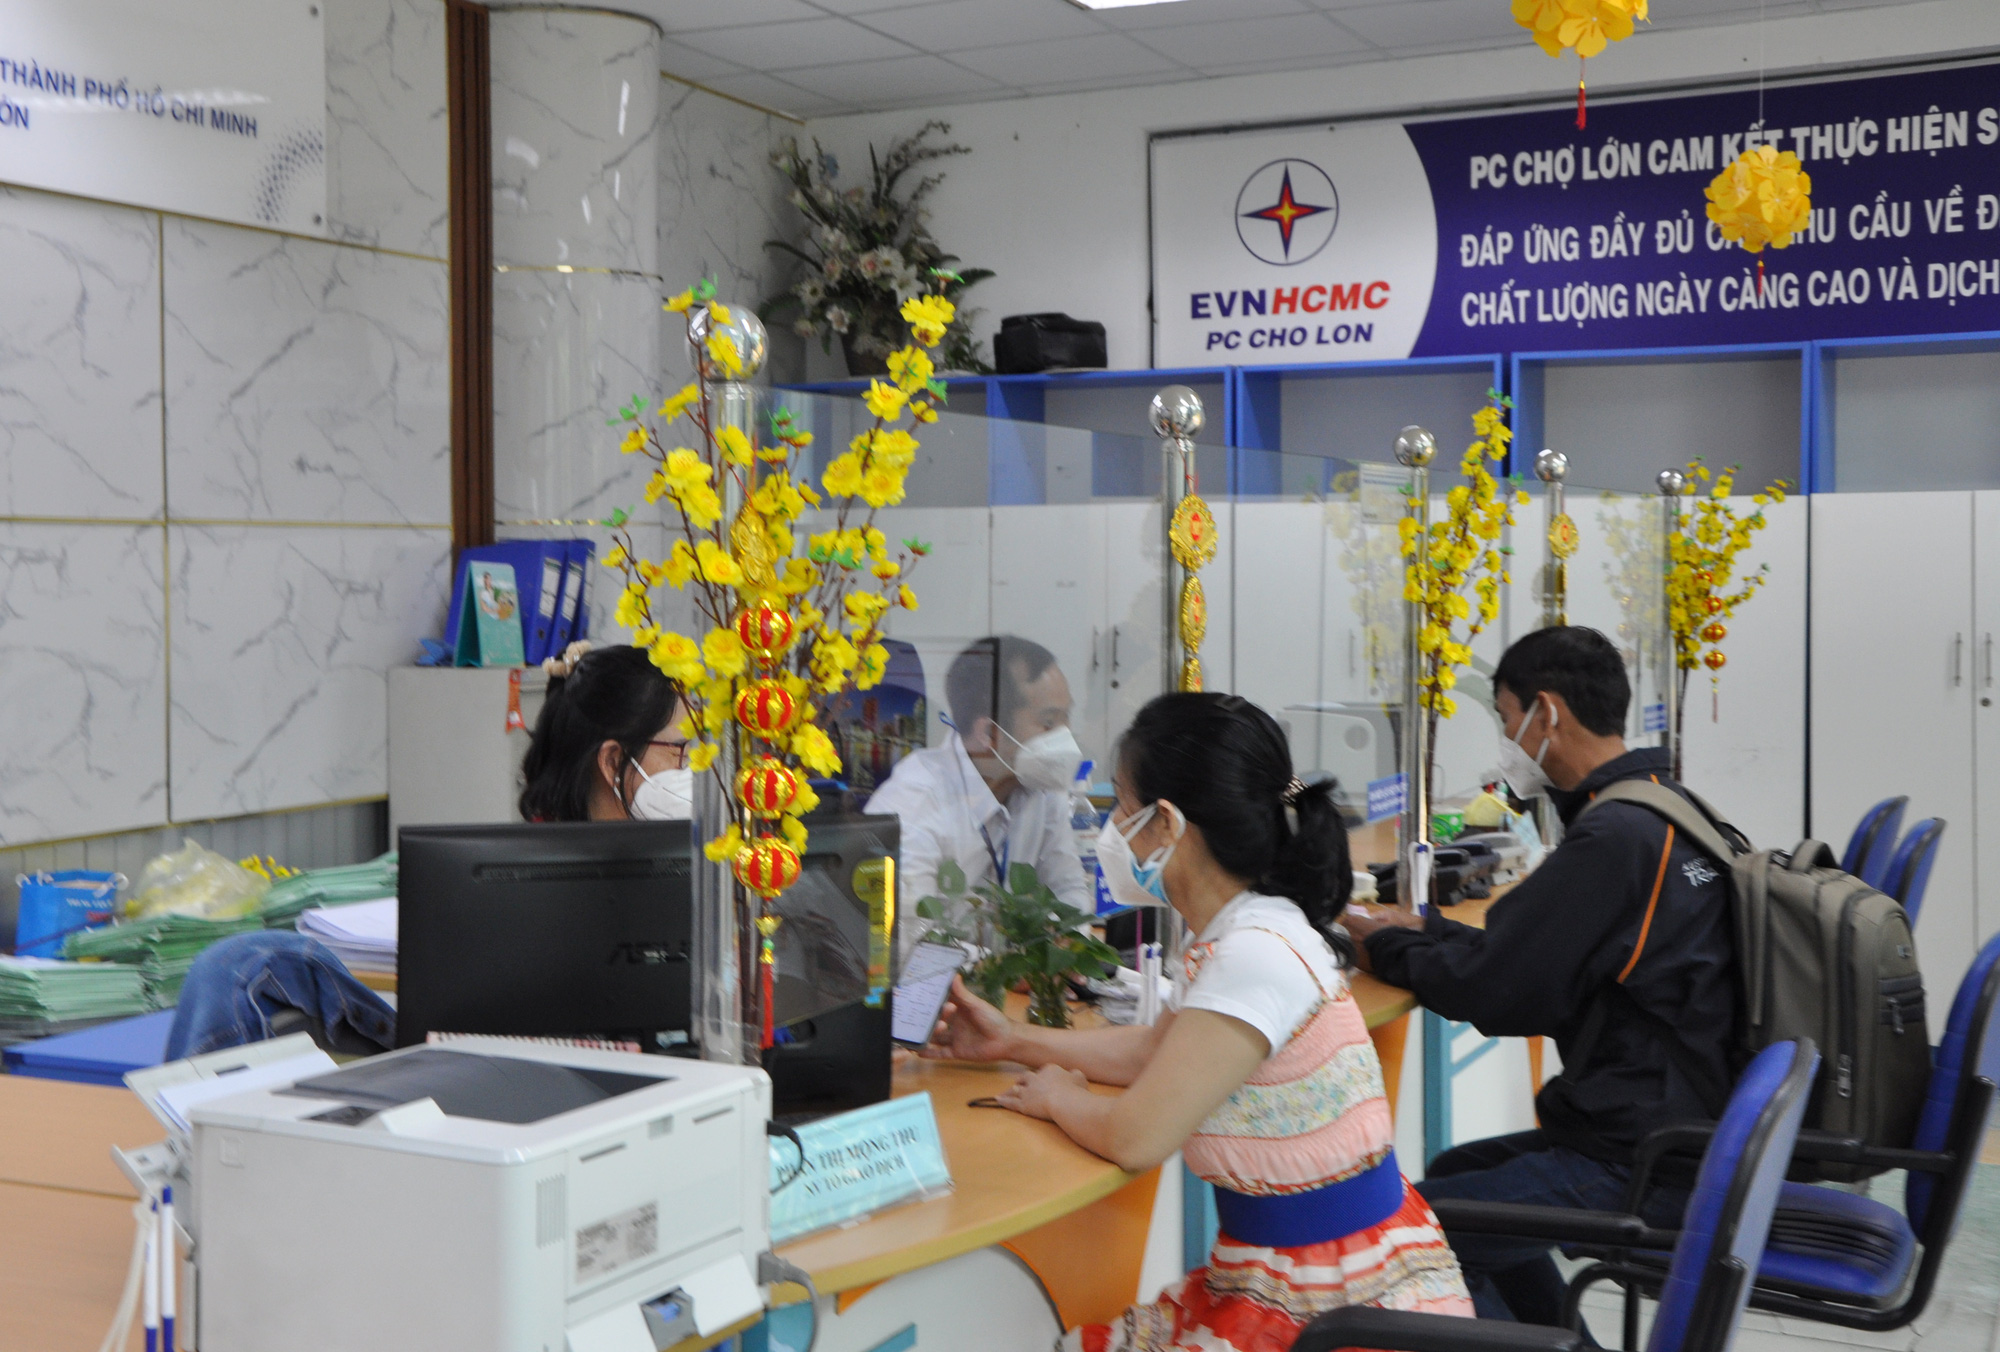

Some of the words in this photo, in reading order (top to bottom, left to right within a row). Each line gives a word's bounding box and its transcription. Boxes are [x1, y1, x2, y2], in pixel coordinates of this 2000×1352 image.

[0, 57, 76, 98] THÀNH
[210, 107, 258, 139] MINH
[1470, 153, 1507, 189] PC
[1512, 143, 1576, 190] CHỢ
[1581, 136, 1641, 180] LỚN
[1647, 135, 1714, 175] CAM
[1790, 116, 1880, 165] THỰC
[1886, 105, 1969, 157] HIỆN
[1460, 224, 1514, 268] ĐÁP
[1523, 222, 1580, 264] ỨNG
[1589, 210, 1646, 259] ĐẦY
[1655, 208, 1694, 254] ĐỦ
[1790, 206, 1836, 246] HU
[1849, 190, 1911, 240] CẦU
[1924, 184, 1965, 234] VỀ
[1461, 278, 1531, 327] CHẤT
[1536, 281, 1629, 328] LƯỢNG
[1635, 271, 1713, 317] NGÀY
[1718, 267, 1799, 312] CÀNG
[1806, 267, 1871, 306] CAO
[1878, 256, 1919, 301] VÀ
[1927, 258, 2000, 306] DỊCH
[1206, 330, 1242, 351] PC
[1248, 326, 1308, 349] CHO
[1315, 322, 1374, 346] LON
